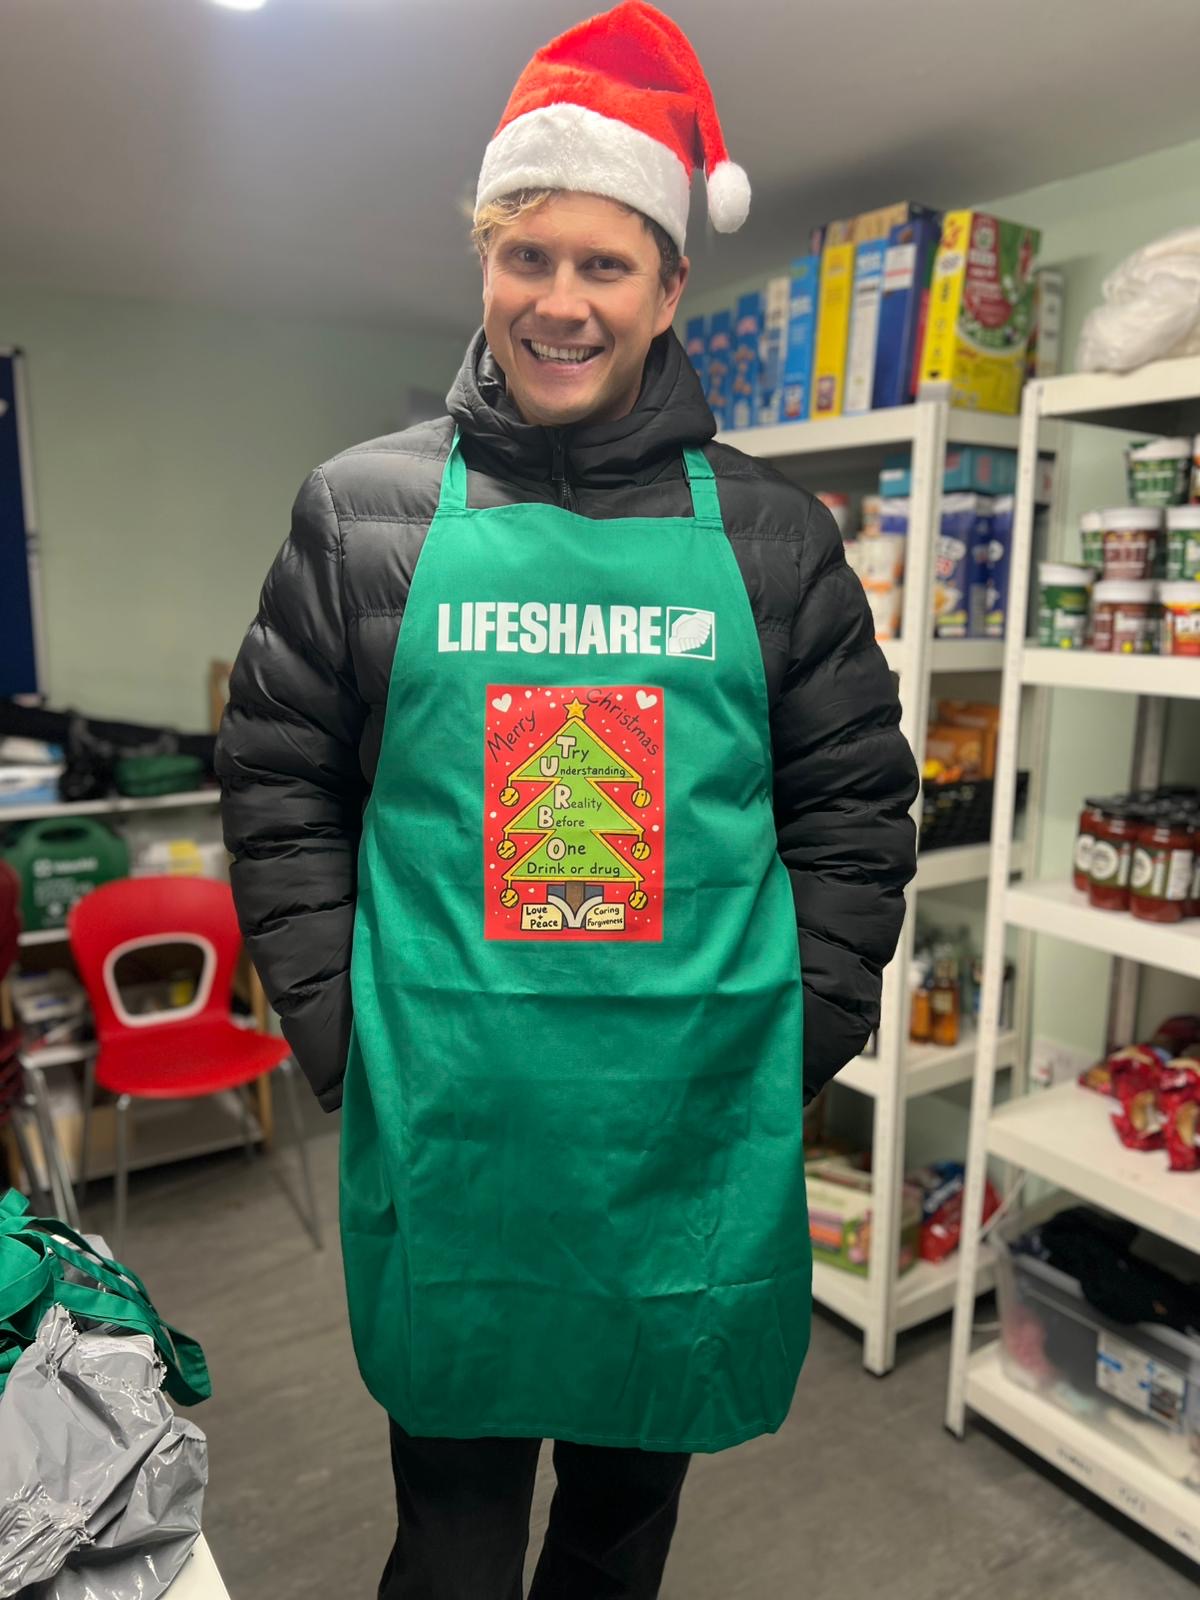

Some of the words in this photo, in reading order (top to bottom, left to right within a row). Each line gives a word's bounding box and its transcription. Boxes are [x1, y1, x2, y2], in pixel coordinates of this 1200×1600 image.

[438, 602, 661, 655] LIFESHARE
[487, 710, 536, 762] Merry
[587, 689, 659, 756] Christmas
[556, 735, 590, 762] Try
[540, 756, 626, 777] Understanding
[554, 784, 602, 811] Reality
[538, 805, 585, 829] Before
[546, 837, 586, 861] One
[527, 862, 565, 875] Drink
[570, 864, 583, 875] or
[590, 862, 620, 877] drug
[526, 906, 548, 915] Love
[594, 907, 620, 915] Caring
[530, 919, 558, 929] Peace
[587, 918, 623, 927] Forgiveness
